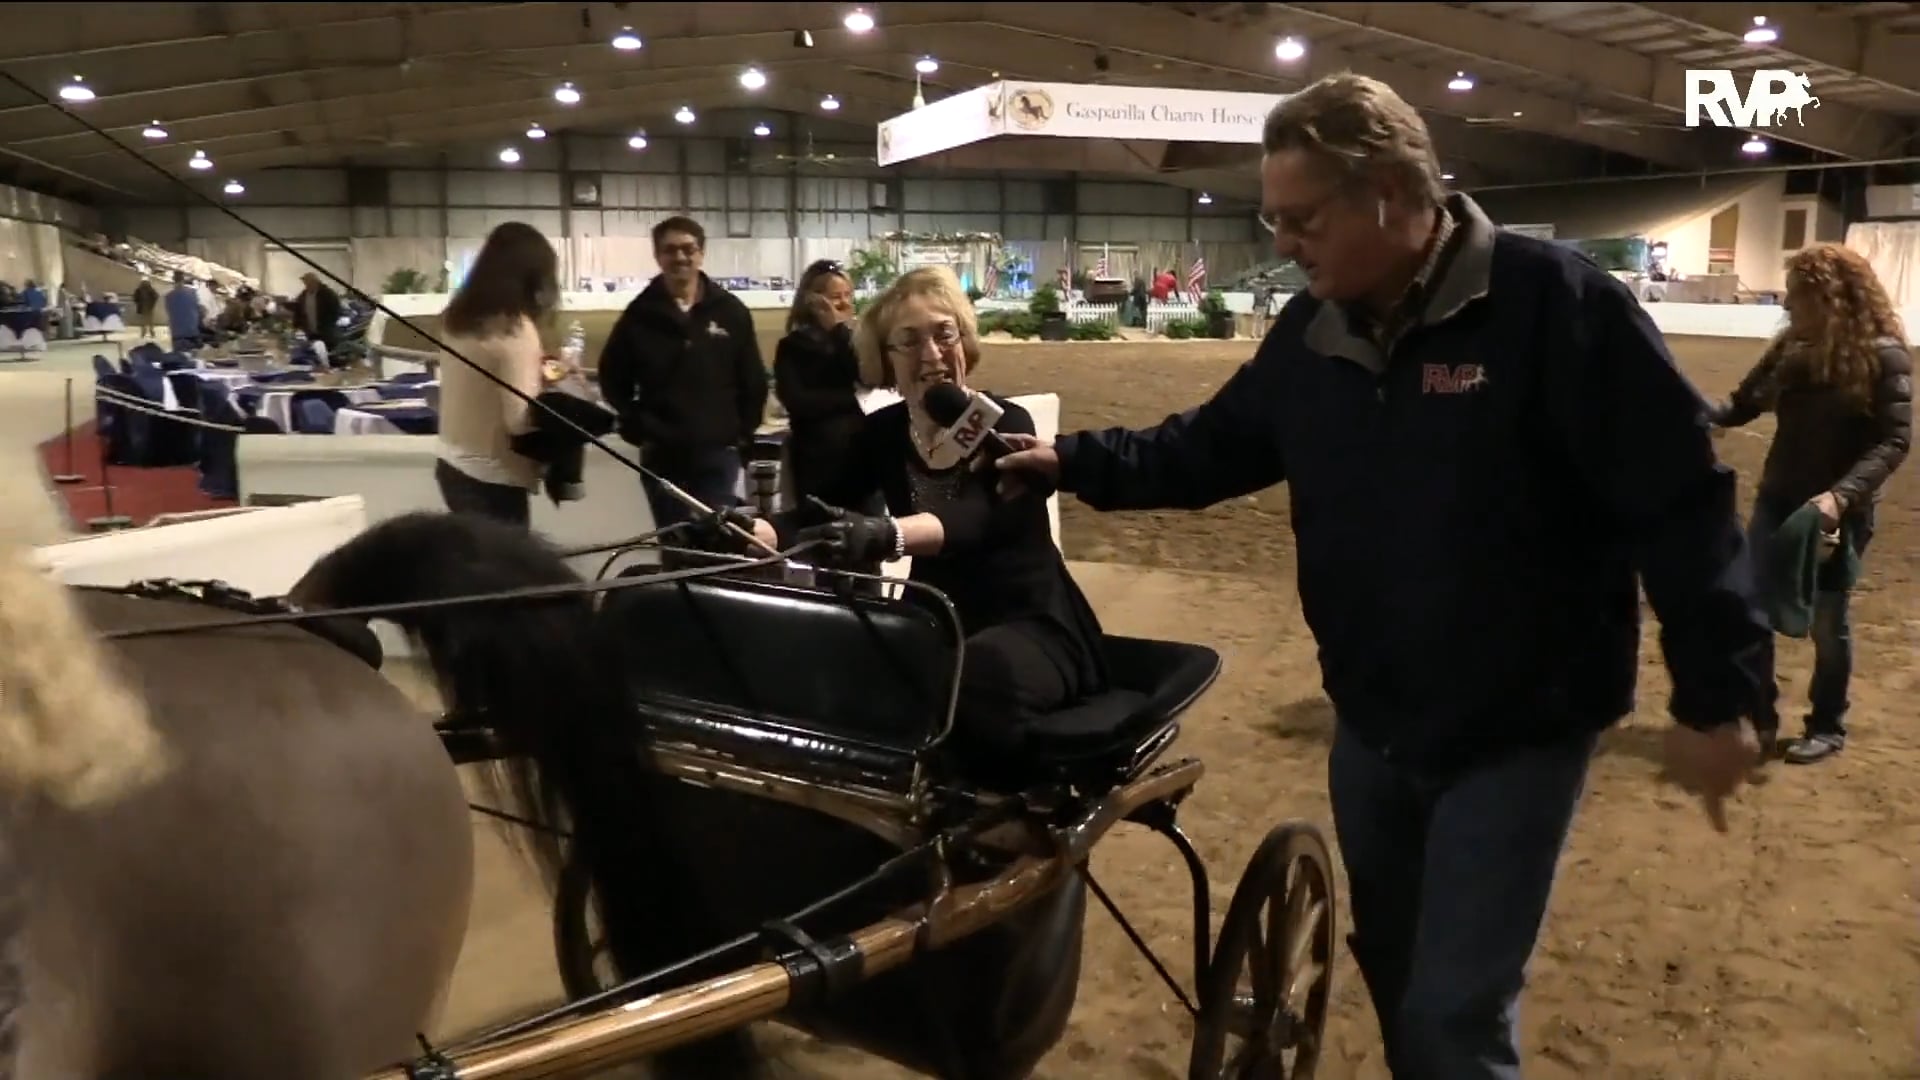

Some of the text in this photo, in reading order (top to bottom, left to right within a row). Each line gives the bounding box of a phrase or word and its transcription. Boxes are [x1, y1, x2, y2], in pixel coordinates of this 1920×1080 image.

[1065, 102, 1147, 123] Gasparilla
[1212, 107, 1258, 124] Horse
[1423, 363, 1480, 393] RVP
